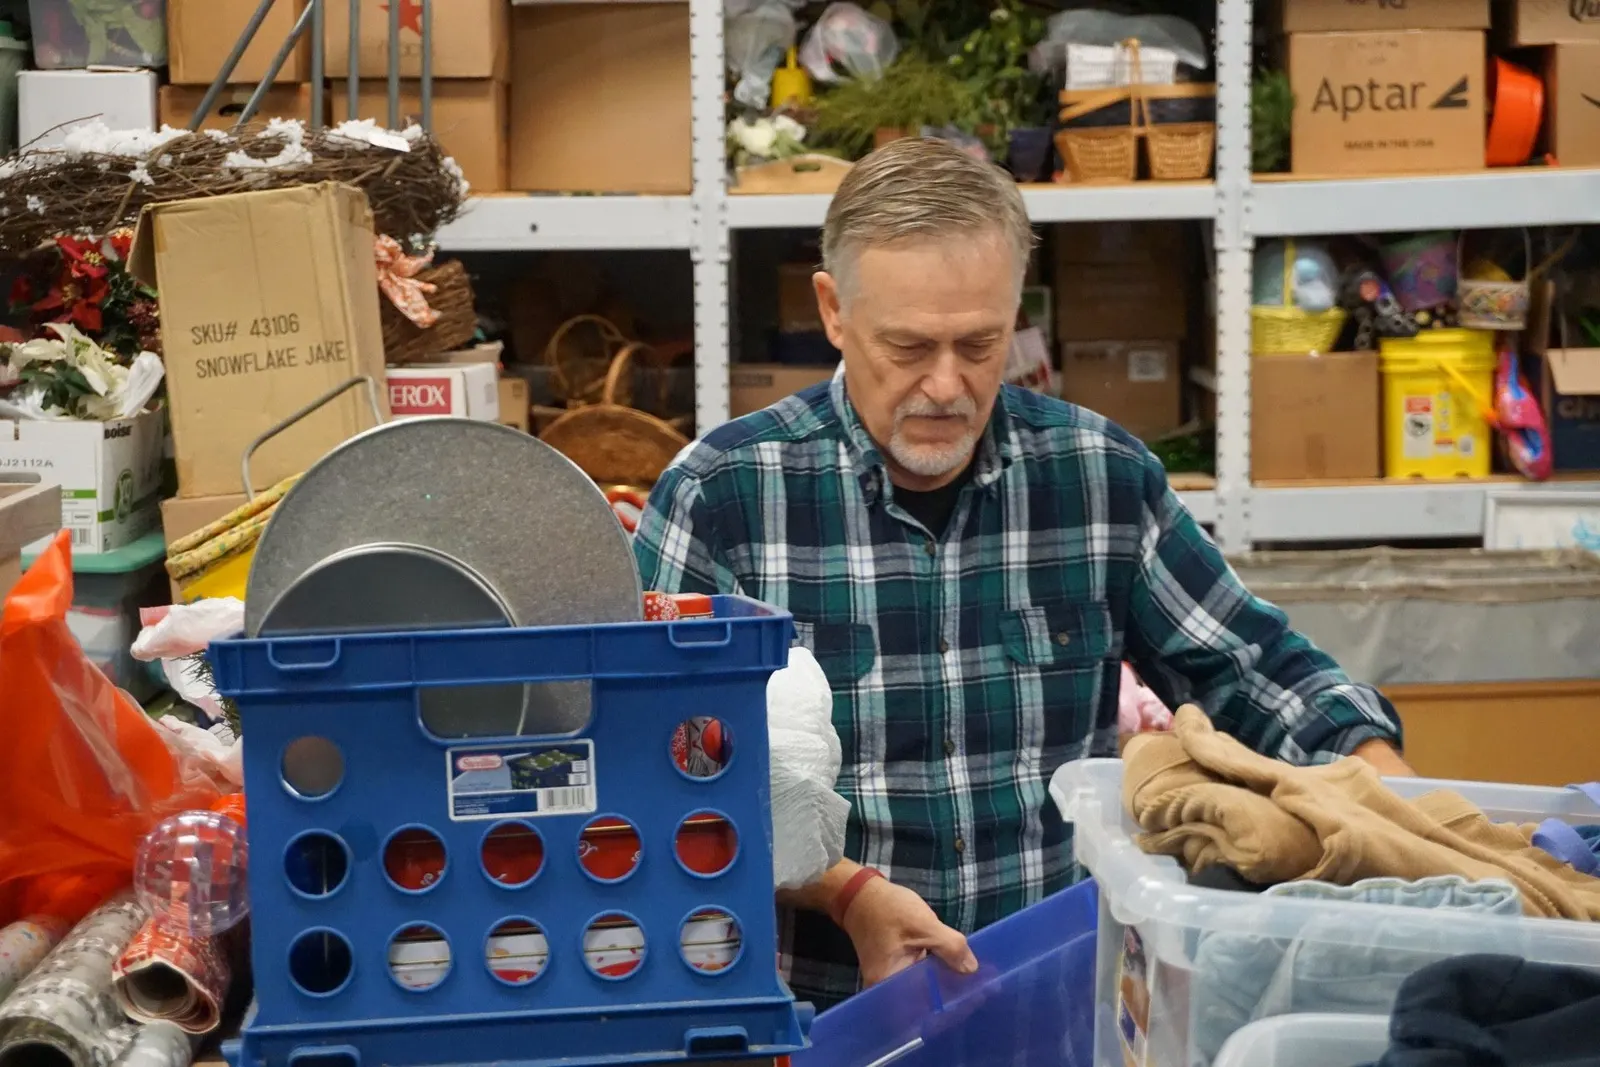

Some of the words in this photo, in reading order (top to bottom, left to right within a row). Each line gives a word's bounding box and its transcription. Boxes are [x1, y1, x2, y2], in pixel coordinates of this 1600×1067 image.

[1311, 75, 1427, 122] Aptar
[191, 321, 238, 345] SKU#
[249, 313, 300, 337] 43106
[195, 347, 298, 378] SNOWFLAKE
[305, 340, 346, 365] JAKE
[390, 384, 446, 407] EROX
